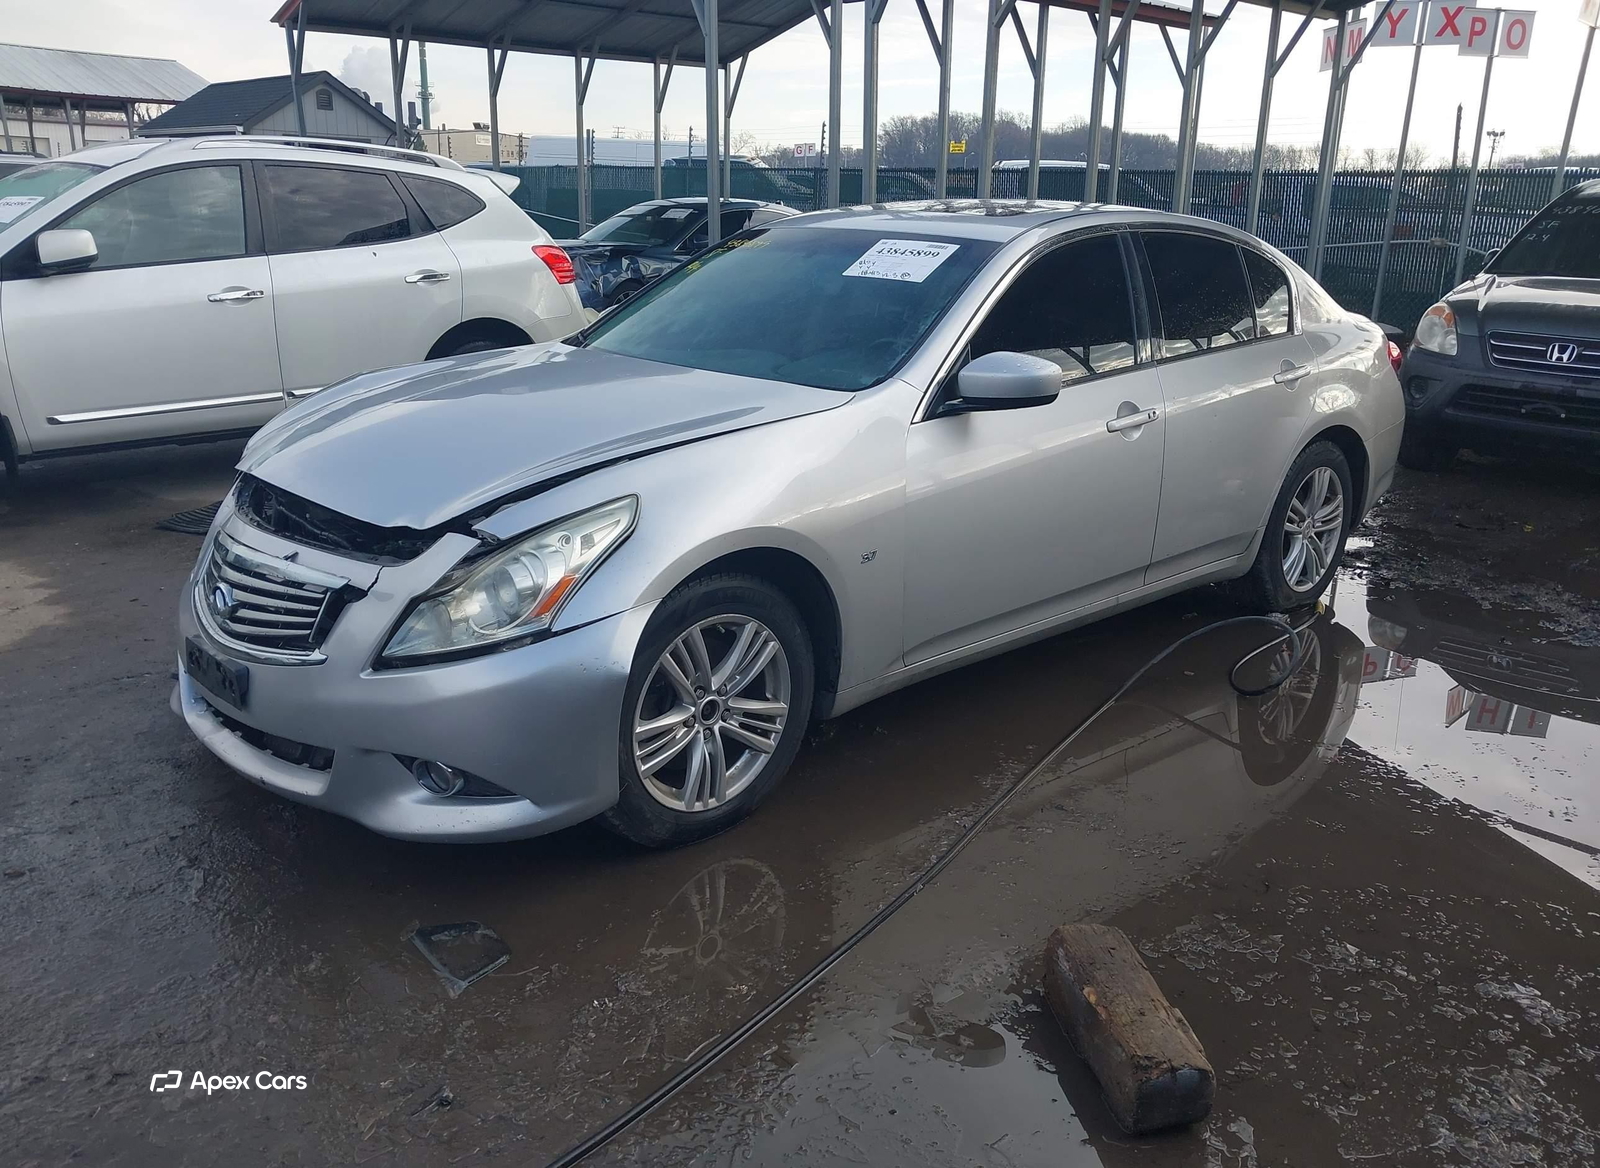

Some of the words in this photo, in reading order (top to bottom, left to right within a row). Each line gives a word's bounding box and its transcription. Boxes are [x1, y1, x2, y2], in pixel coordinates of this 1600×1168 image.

[1386, 9, 1409, 38] Y
[1435, 6, 1465, 37] X
[1467, 16, 1487, 47] P
[1506, 18, 1527, 50] O
[1347, 27, 1362, 58] M
[796, 145, 803, 155] G
[808, 145, 814, 154] F
[876, 246, 941, 259] 43845899
